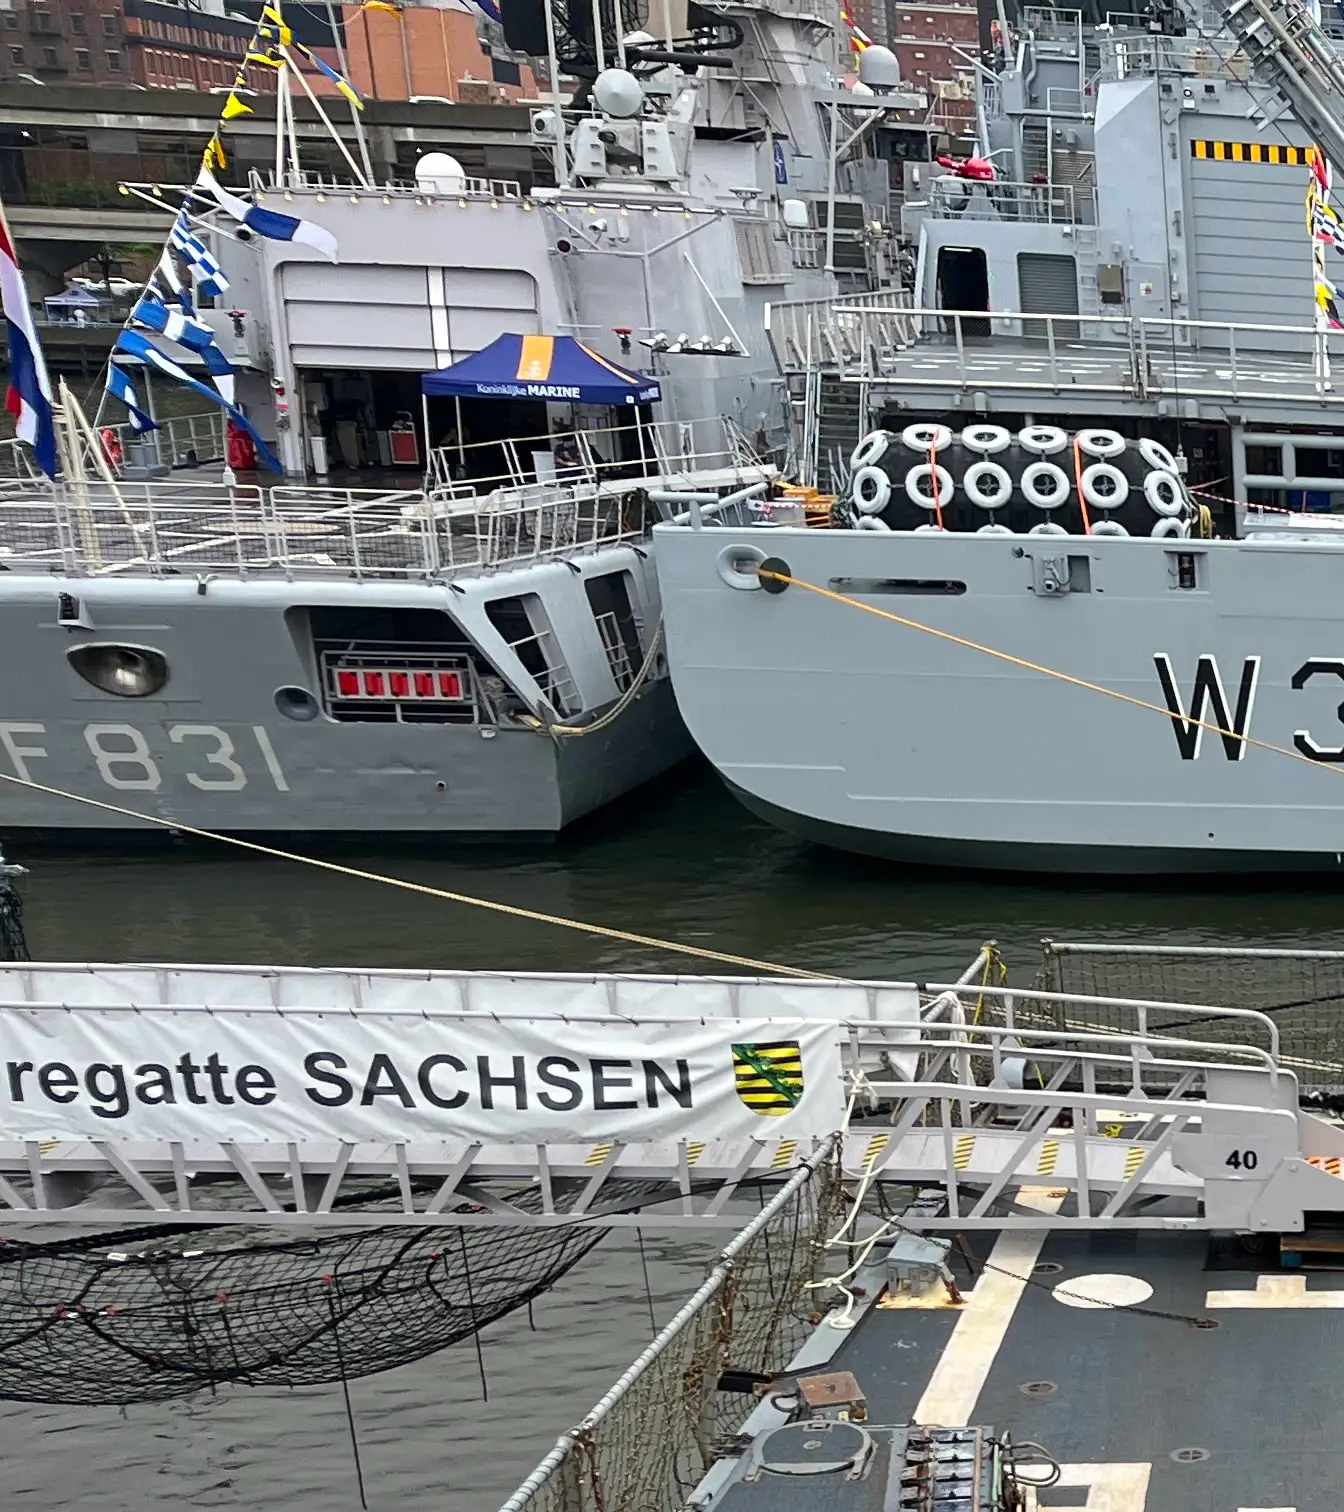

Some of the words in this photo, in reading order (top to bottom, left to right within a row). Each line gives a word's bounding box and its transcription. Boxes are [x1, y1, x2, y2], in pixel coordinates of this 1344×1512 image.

[476, 383, 528, 398] Koninklijke
[527, 384, 581, 399] MARINE
[303, 1050, 695, 1112] SACHSEN
[1225, 1149, 1258, 1171] 40
